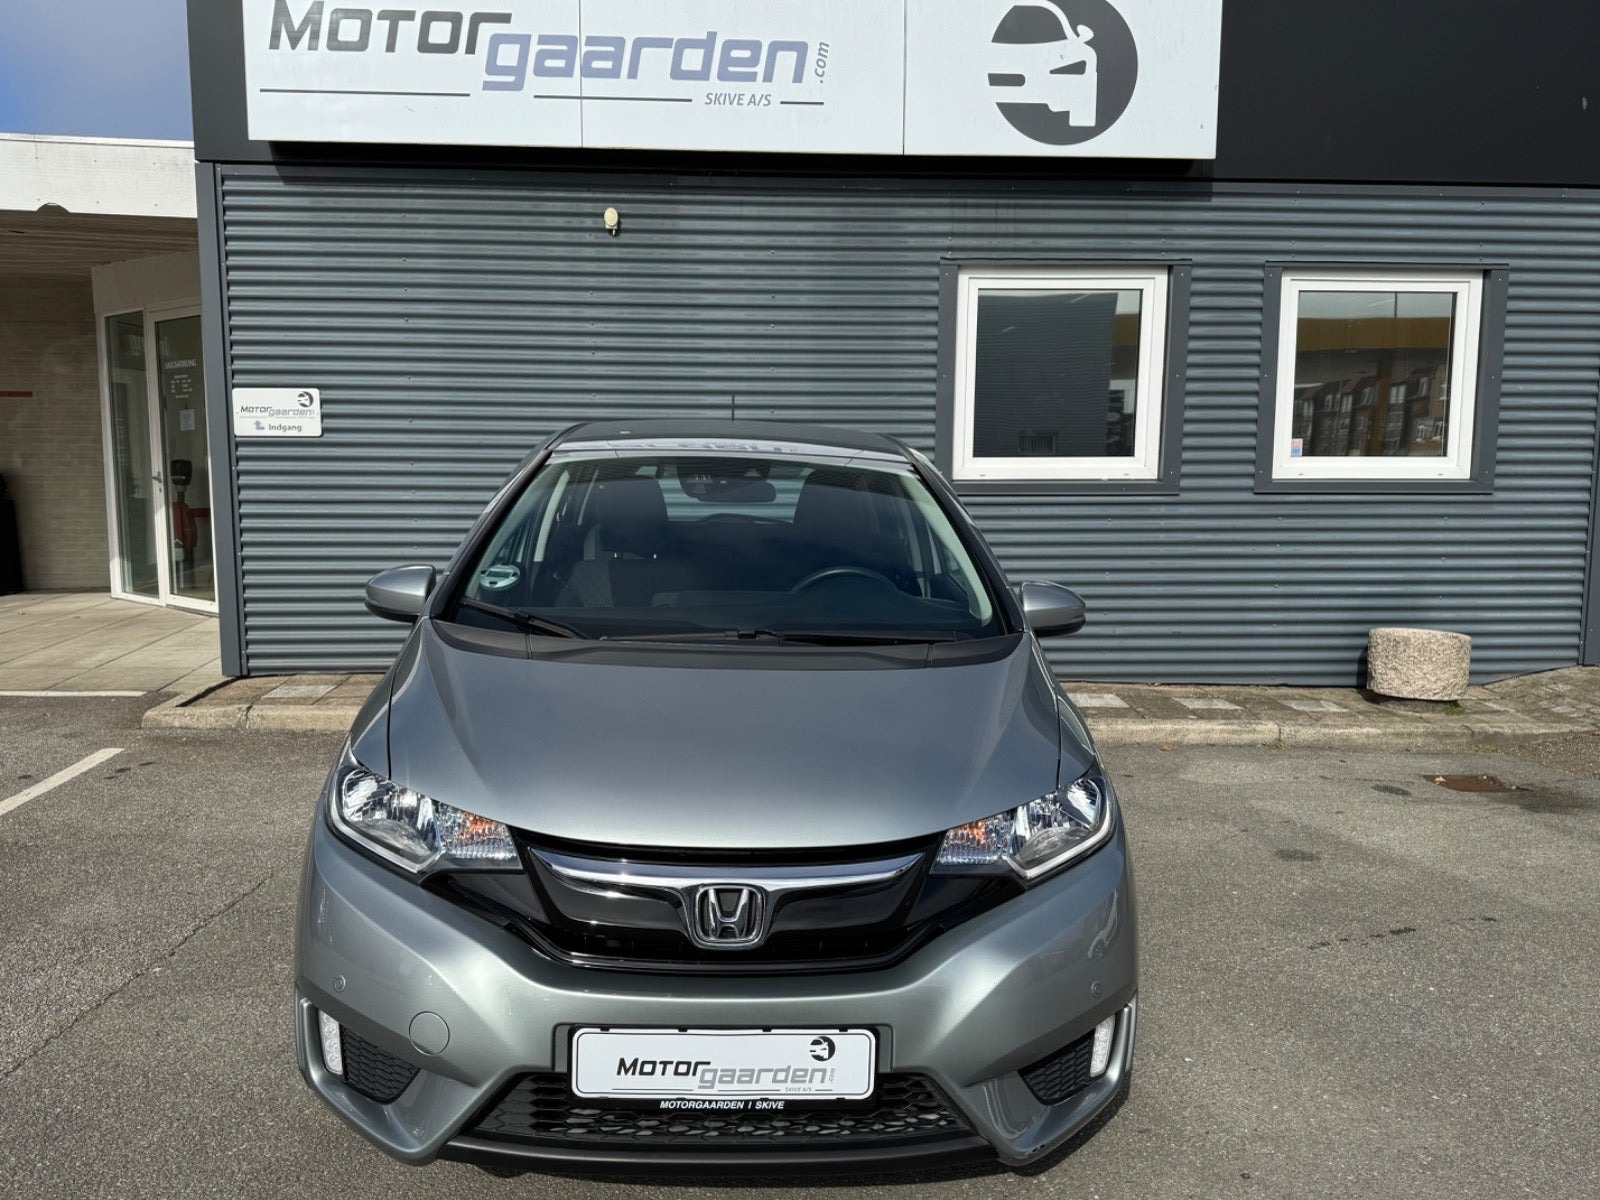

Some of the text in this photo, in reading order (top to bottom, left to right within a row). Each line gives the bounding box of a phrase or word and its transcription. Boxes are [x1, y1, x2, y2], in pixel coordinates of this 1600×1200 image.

[704, 92, 772, 107] SKIVE A/S
[268, 423, 302, 433] Indgang
[660, 1100, 744, 1109] MOTORGAARDEN
[755, 1100, 785, 1110] SKIVE
